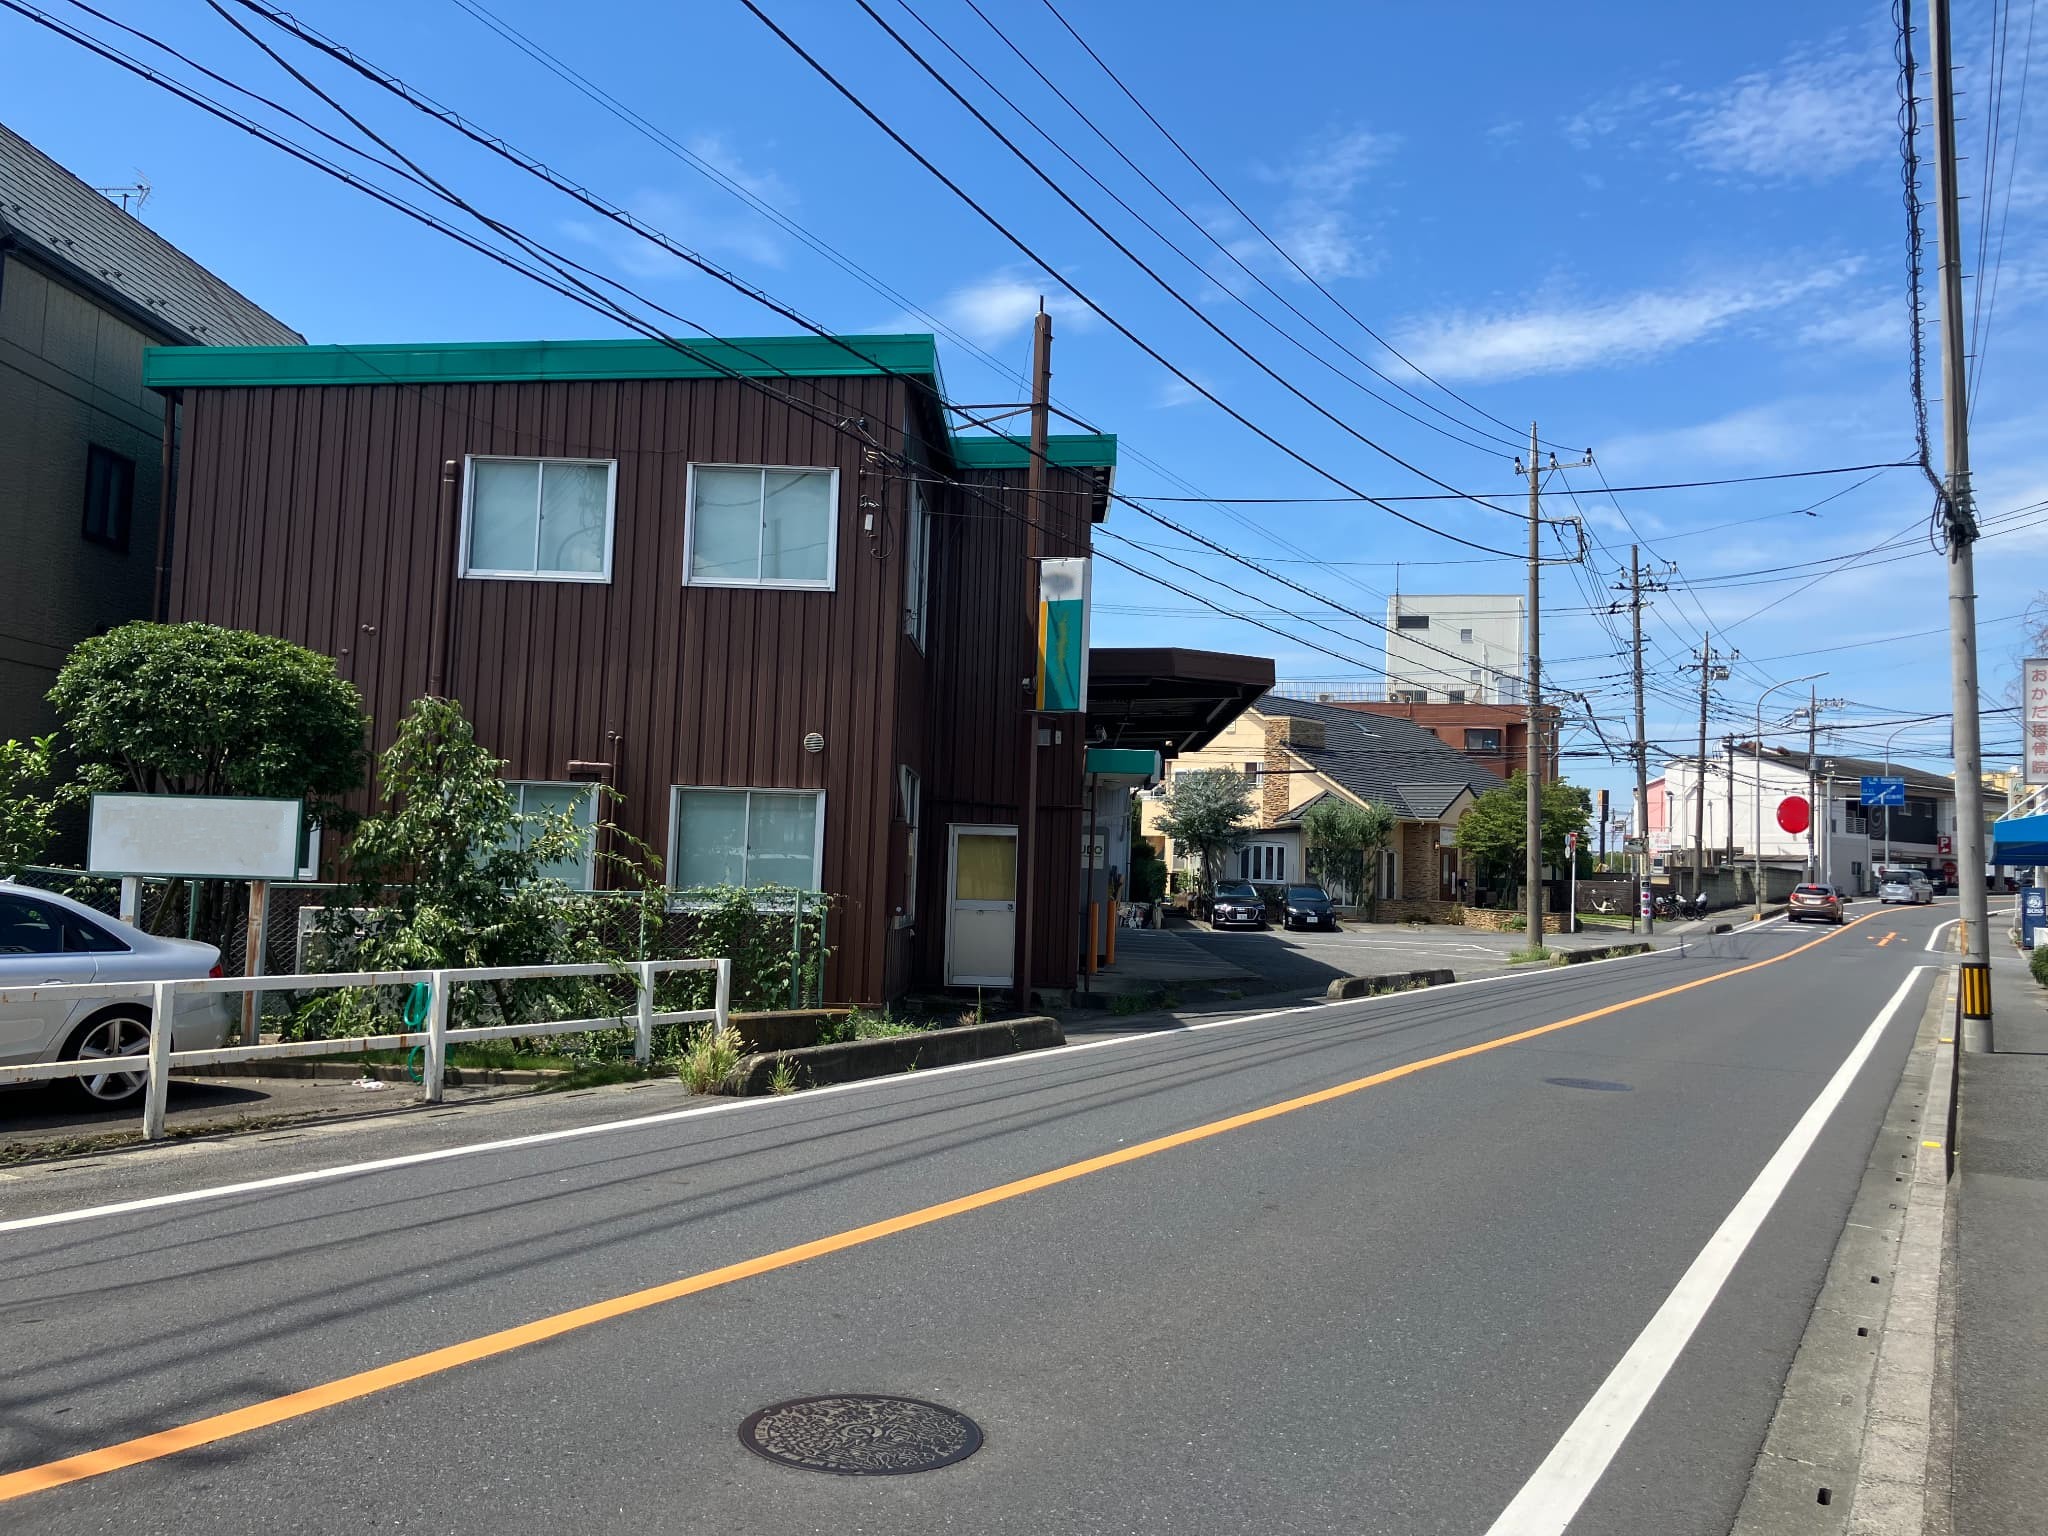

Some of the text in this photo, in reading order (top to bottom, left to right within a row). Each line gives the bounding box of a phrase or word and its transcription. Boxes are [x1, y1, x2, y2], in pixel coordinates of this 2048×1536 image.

[2031, 669, 2048, 775] おかだ接骨院
